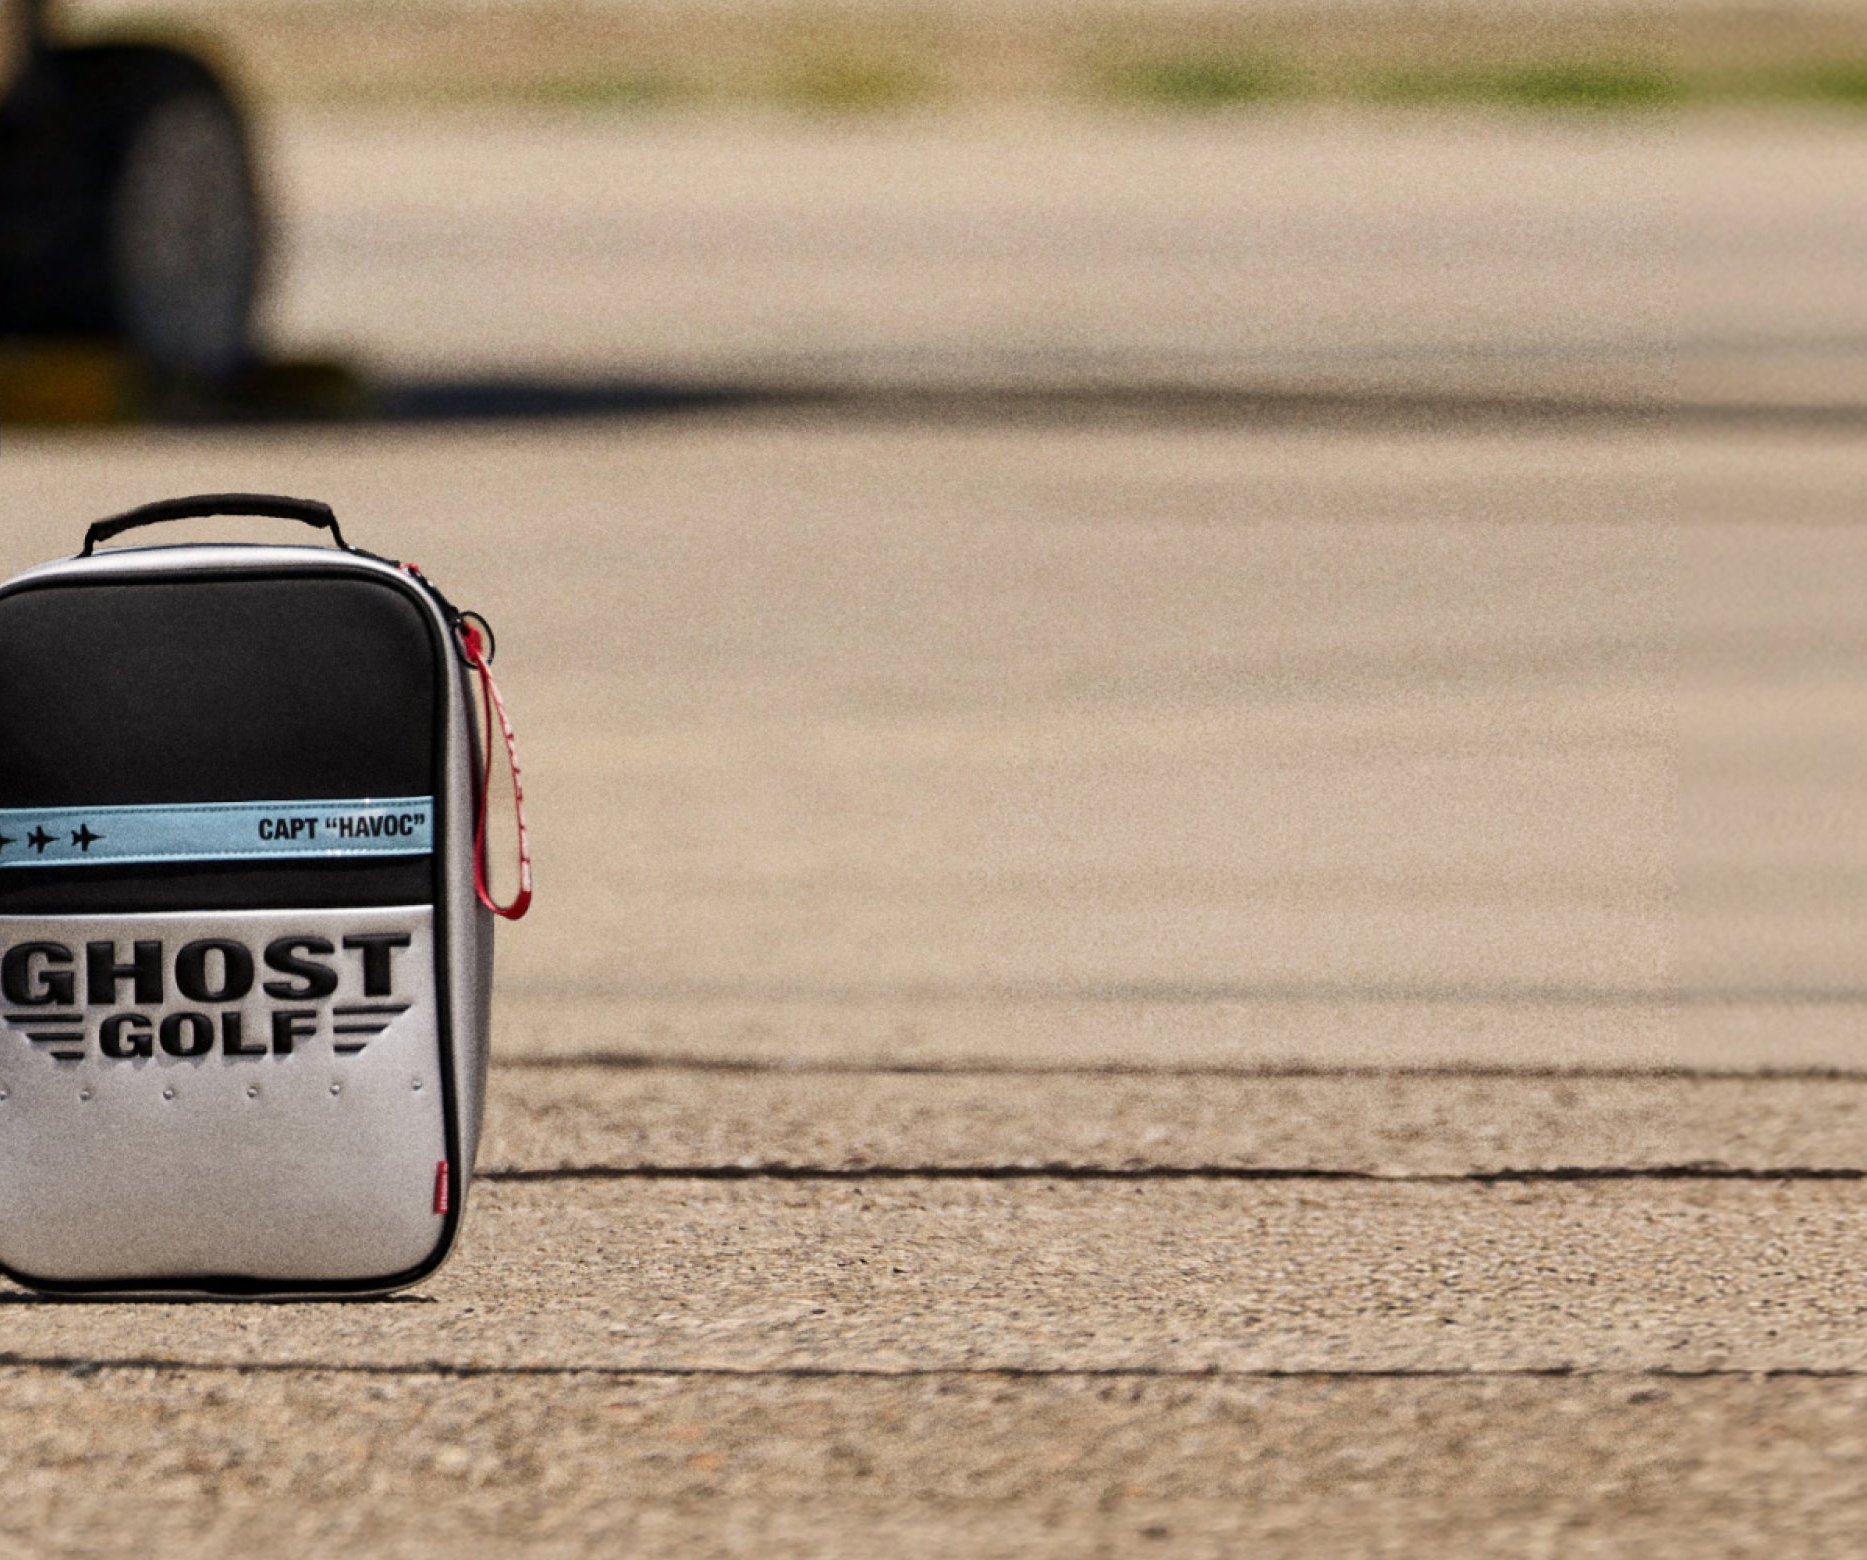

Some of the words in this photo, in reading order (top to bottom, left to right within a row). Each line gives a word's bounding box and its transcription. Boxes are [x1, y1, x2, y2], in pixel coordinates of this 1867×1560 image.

[258, 818, 318, 840] CAPT
[1, 932, 412, 1007] GHOST
[99, 1009, 317, 1059] GOLF
